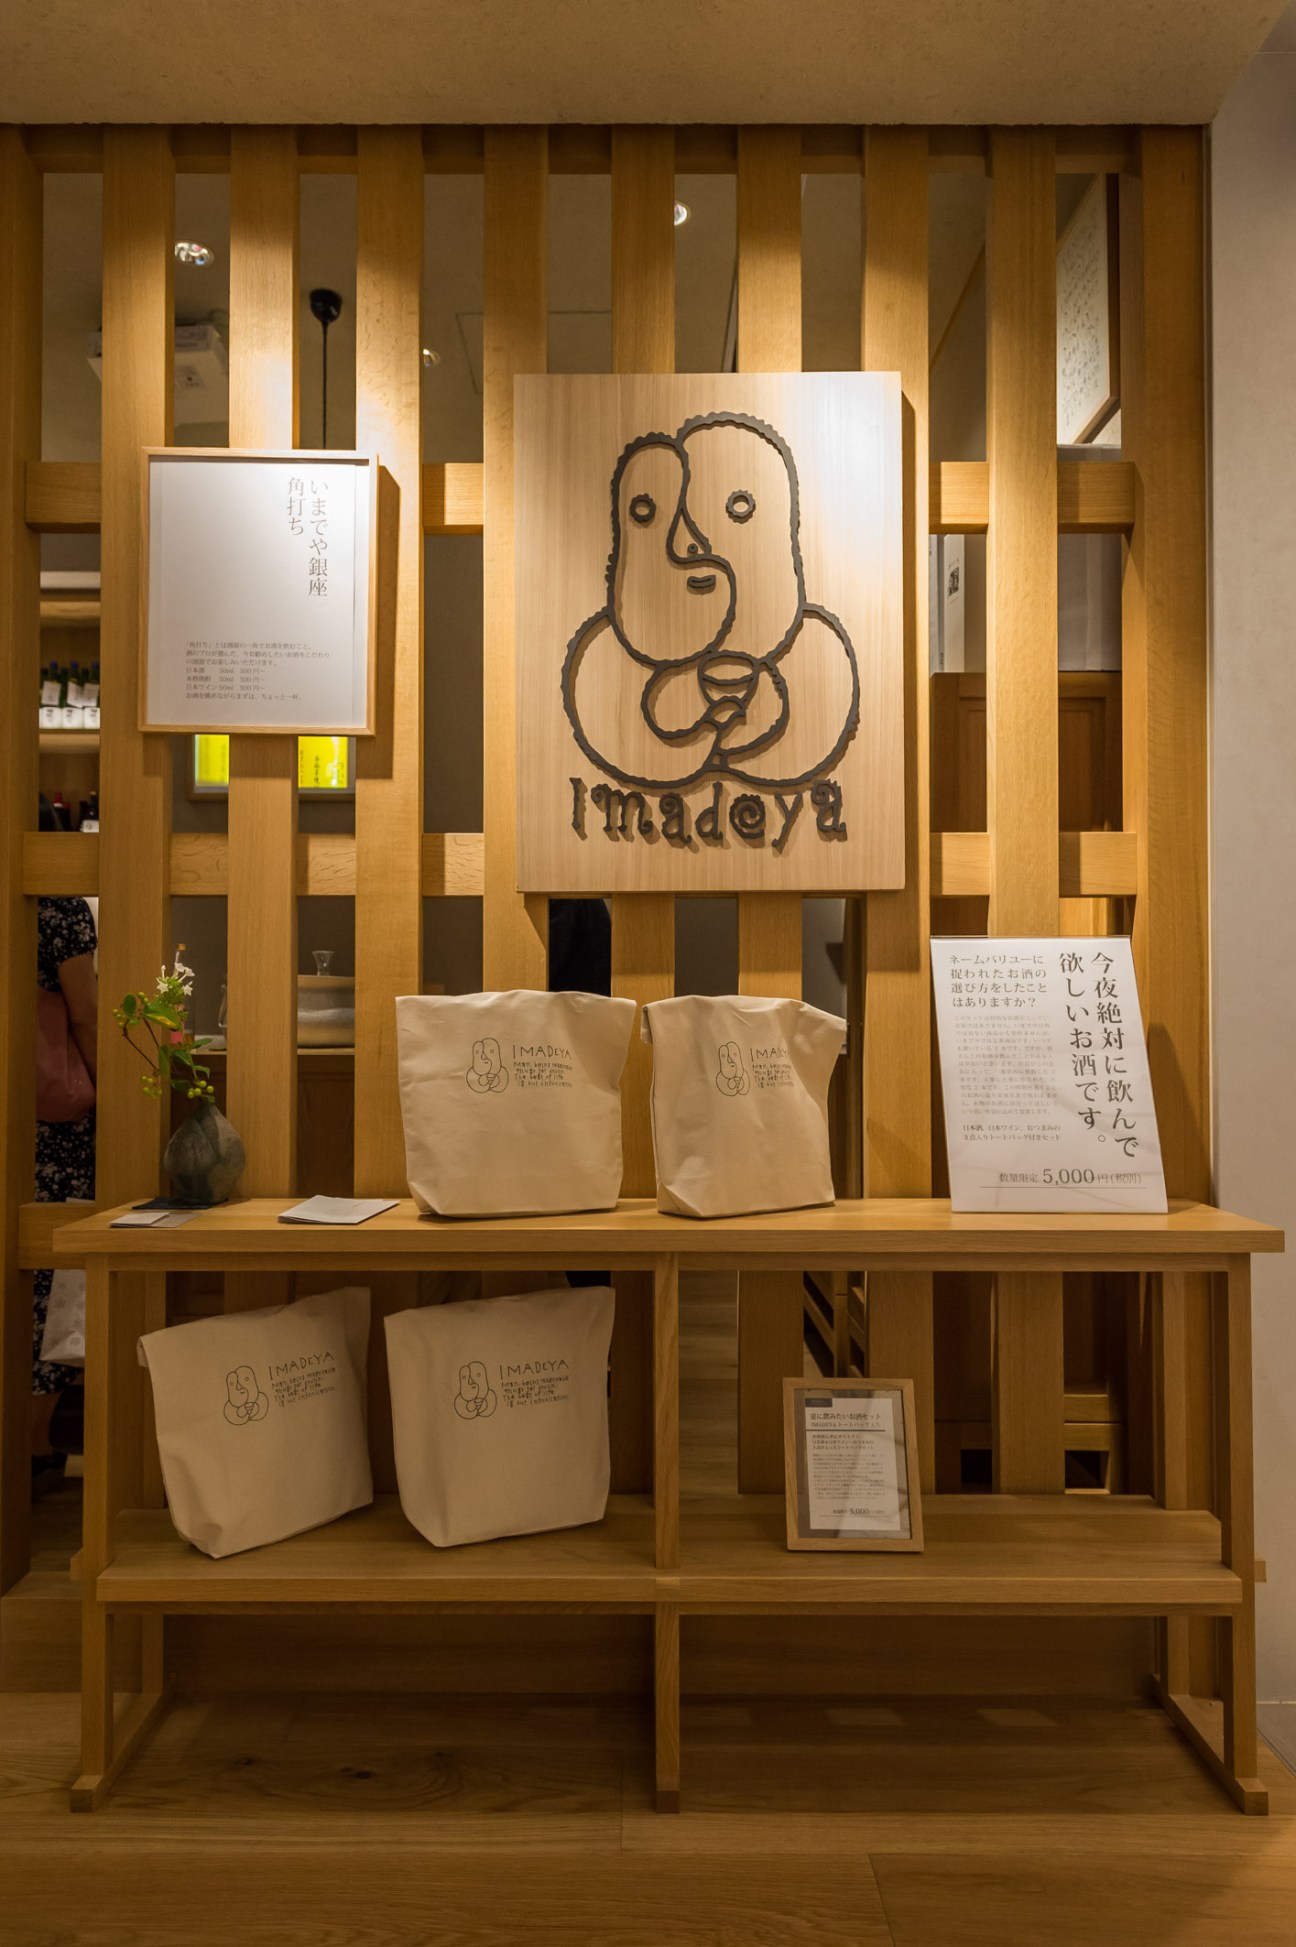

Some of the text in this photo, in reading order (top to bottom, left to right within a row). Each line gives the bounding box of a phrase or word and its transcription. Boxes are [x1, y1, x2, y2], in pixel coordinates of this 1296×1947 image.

[286, 477, 306, 536] 角打ち
[309, 479, 329, 597] いまでや銀座
[569, 777, 846, 852] Imadeya
[951, 982, 1047, 993] 選び方をしたこと
[513, 1044, 572, 1061] IMADEYA
[1058, 952, 1107, 1143] 欲しいお酒です。
[1090, 951, 1139, 1158] 今夜絶対に飲んで
[268, 1352, 335, 1381] IMADEYA
[499, 1359, 569, 1380] IMADEYA
